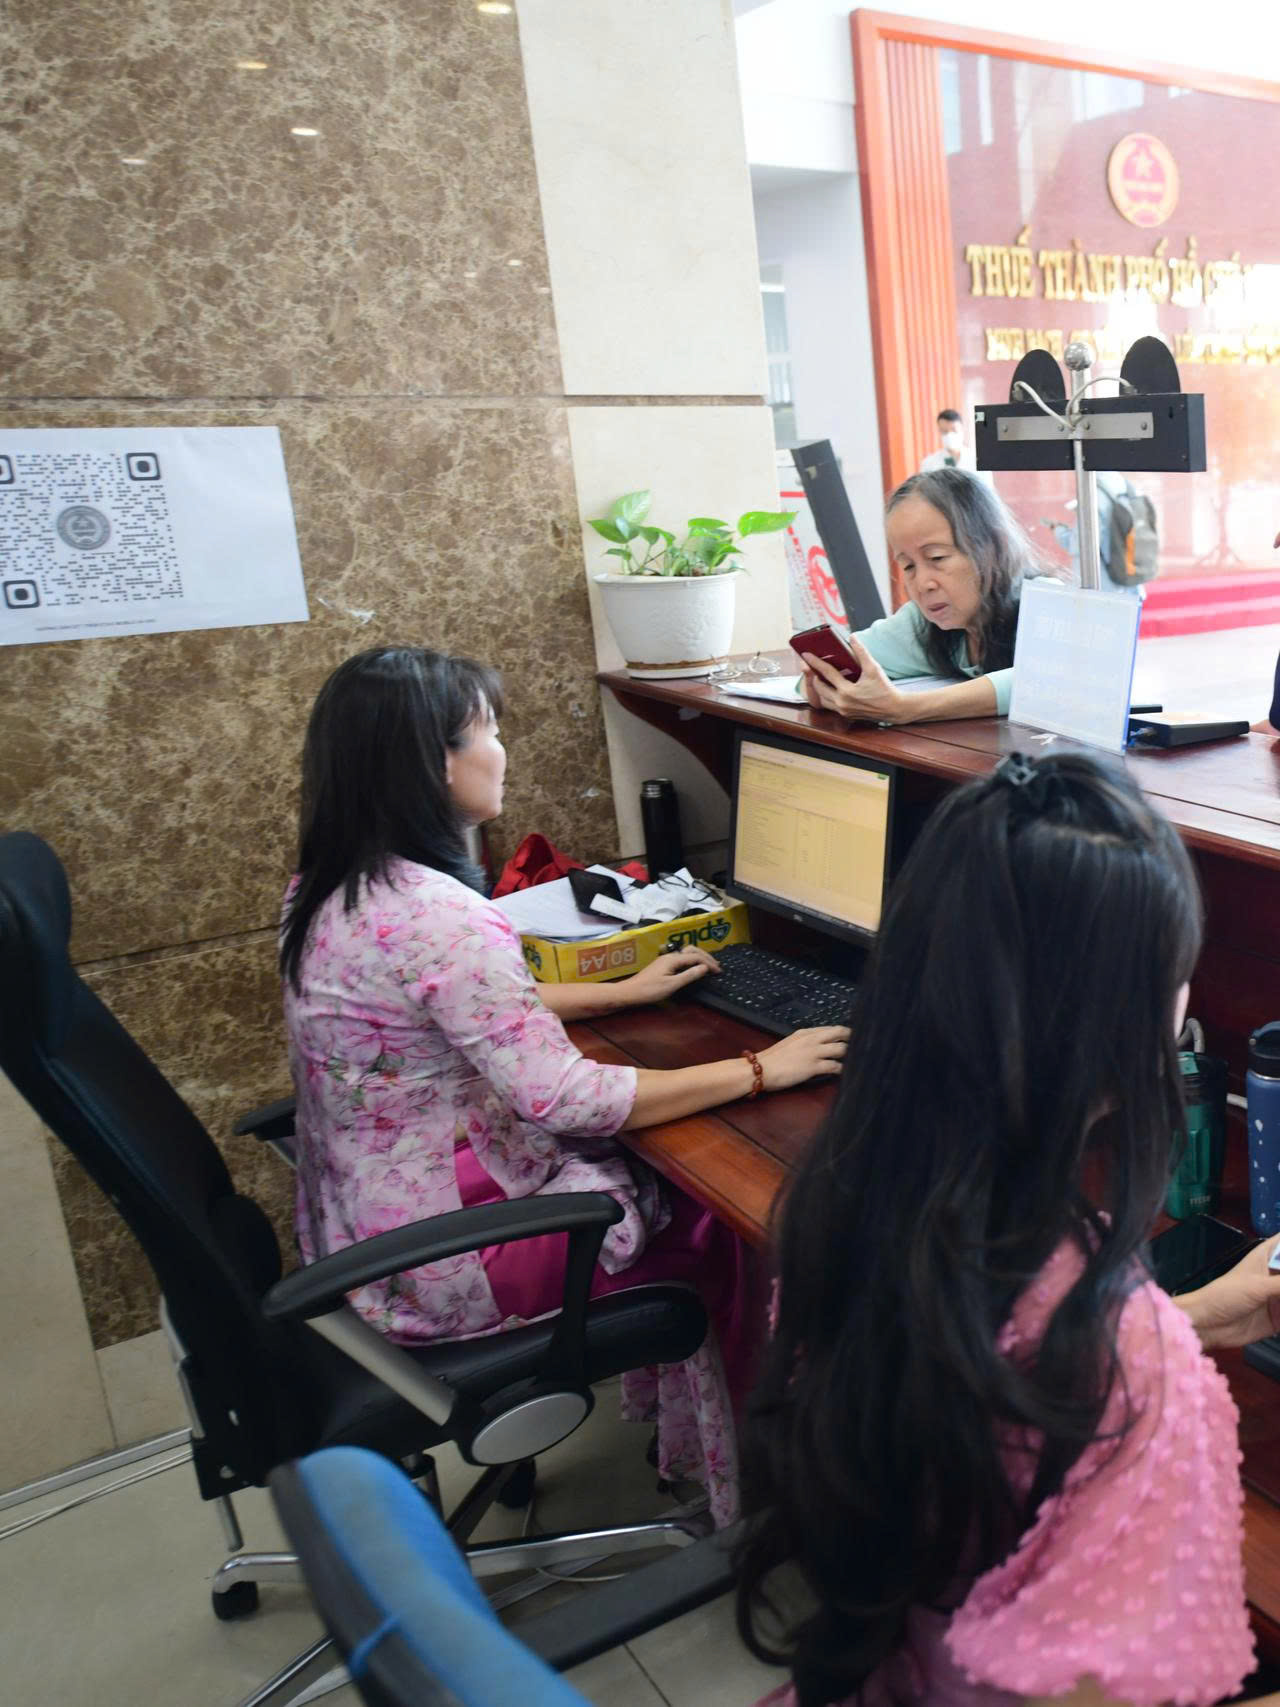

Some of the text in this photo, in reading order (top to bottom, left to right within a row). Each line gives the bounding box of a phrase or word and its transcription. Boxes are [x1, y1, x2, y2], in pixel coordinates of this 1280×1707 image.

[966, 224, 1034, 298] THUẾ
[1038, 238, 1122, 303] THÀNH
[1124, 237, 1170, 304] PHỐ
[1170, 234, 1203, 307] HỒ
[580, 947, 634, 973] 80 A4
